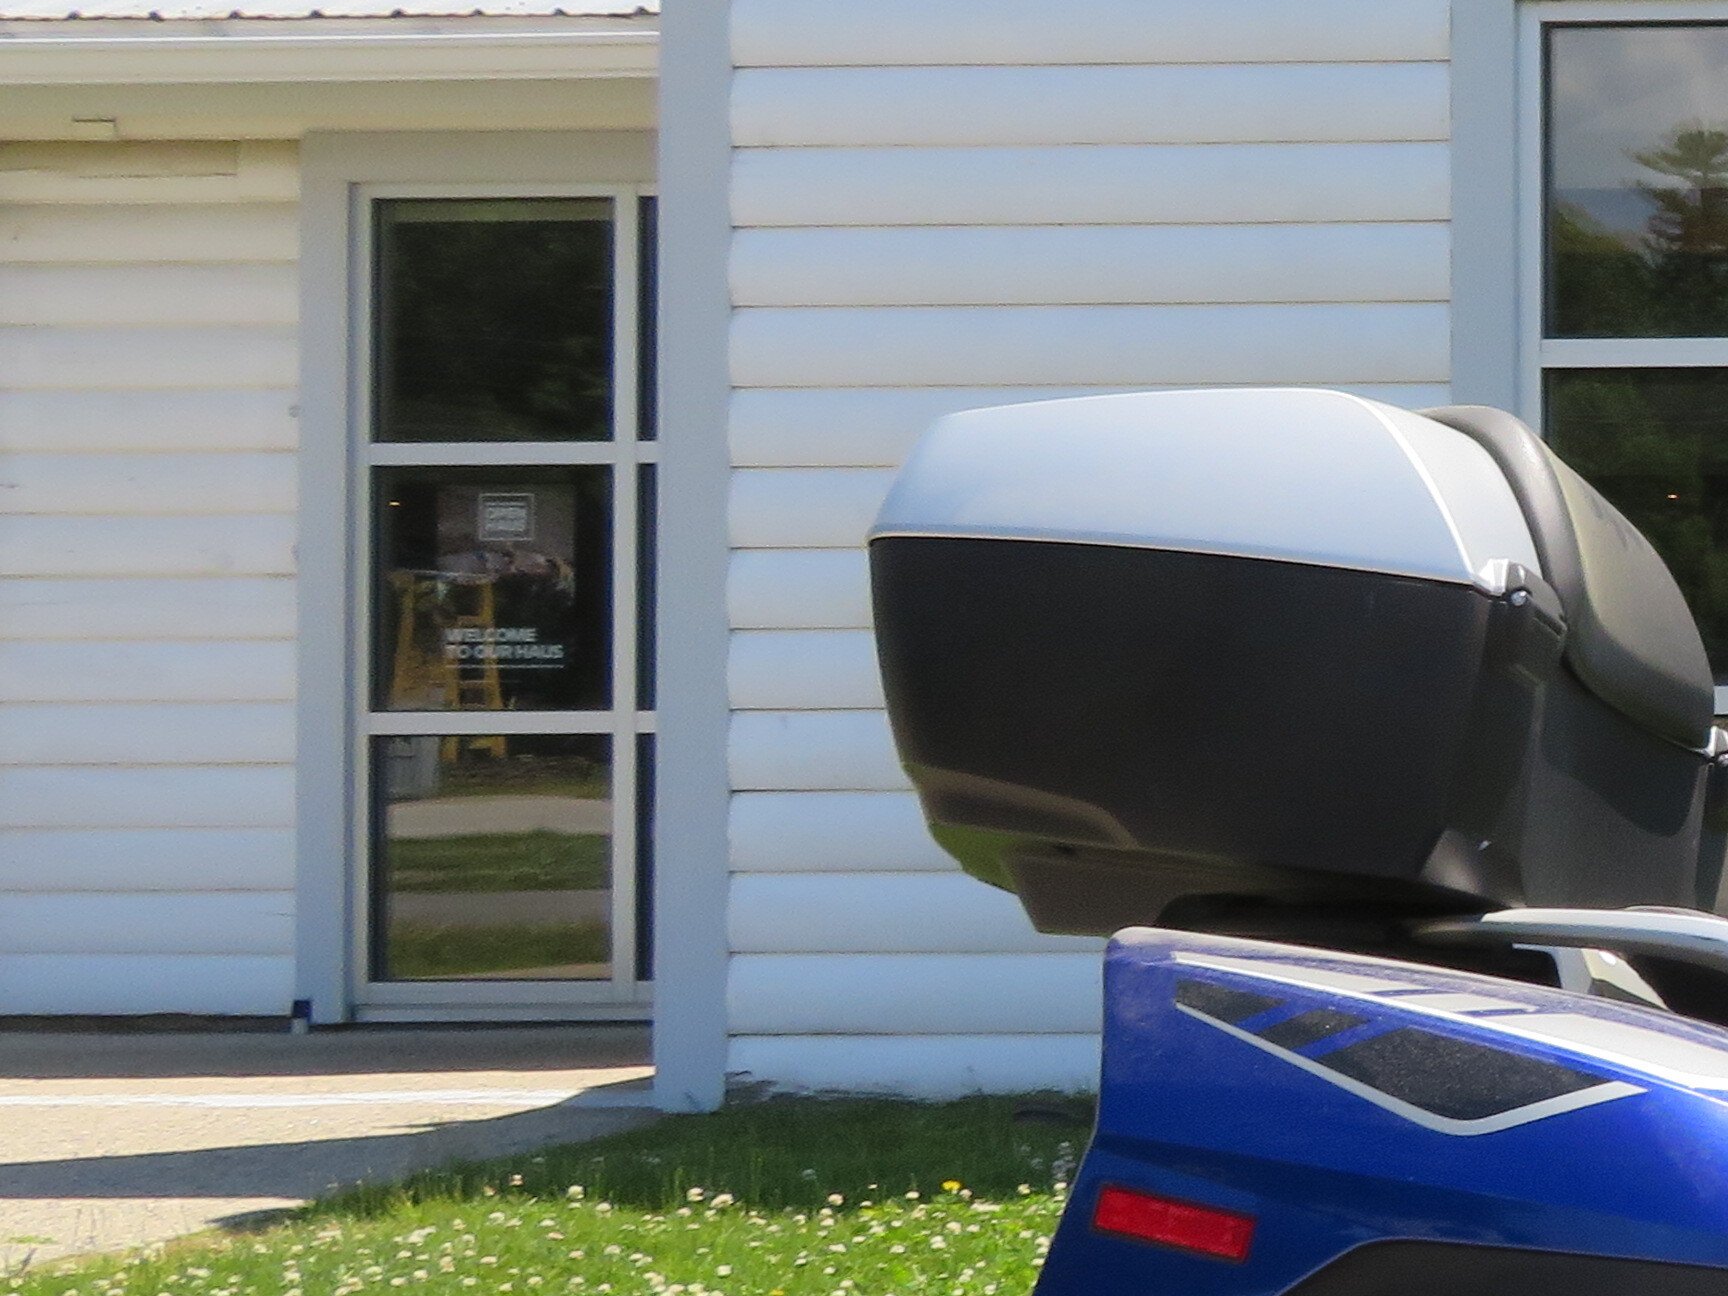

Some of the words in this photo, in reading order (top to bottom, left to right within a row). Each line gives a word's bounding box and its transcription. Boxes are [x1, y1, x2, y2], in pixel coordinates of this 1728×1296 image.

[444, 627, 539, 643] WELCOME
[445, 644, 471, 659] TO
[473, 644, 514, 659] OUR
